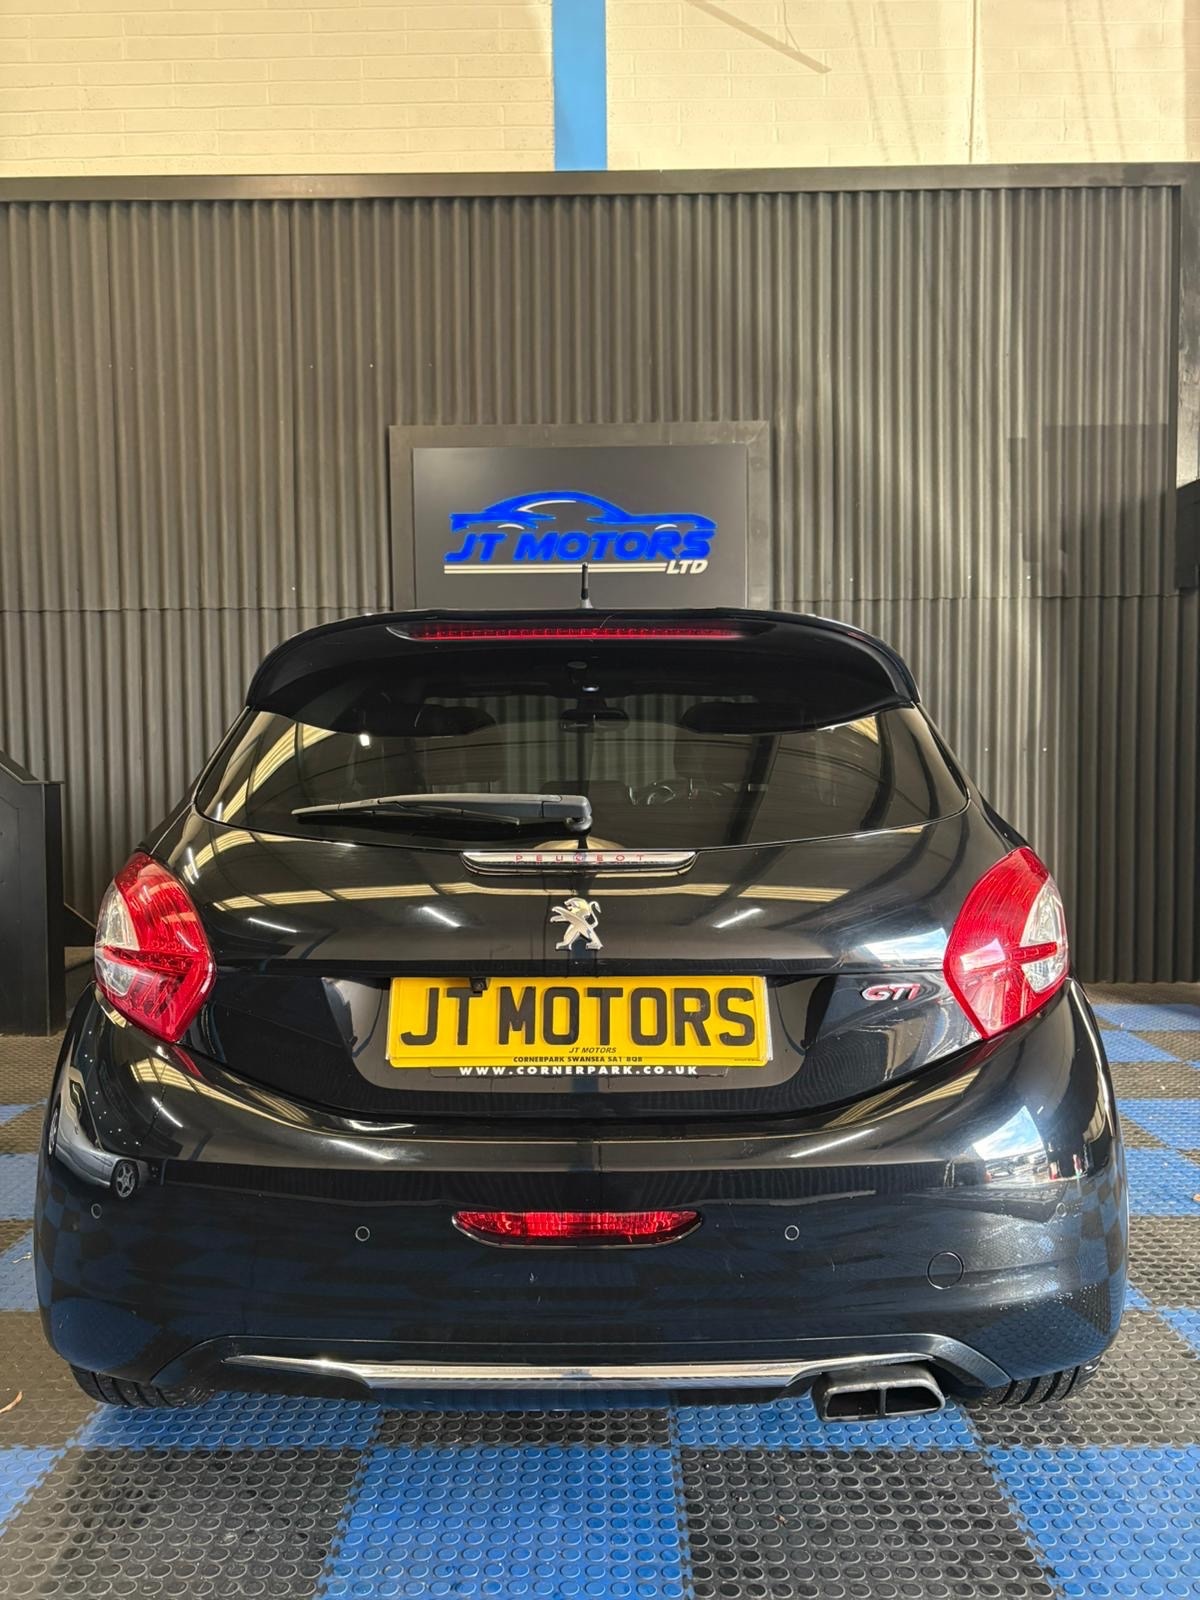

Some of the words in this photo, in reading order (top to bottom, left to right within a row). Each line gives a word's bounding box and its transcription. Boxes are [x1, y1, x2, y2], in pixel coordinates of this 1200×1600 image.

[444, 533, 506, 561] JT
[513, 530, 715, 561] MOTORS
[666, 559, 709, 574] LTD
[400, 987, 482, 1046] JT
[498, 986, 756, 1047] MOTORS
[459, 1066, 698, 1075] WWW.CORNERPARK.CO.UK
